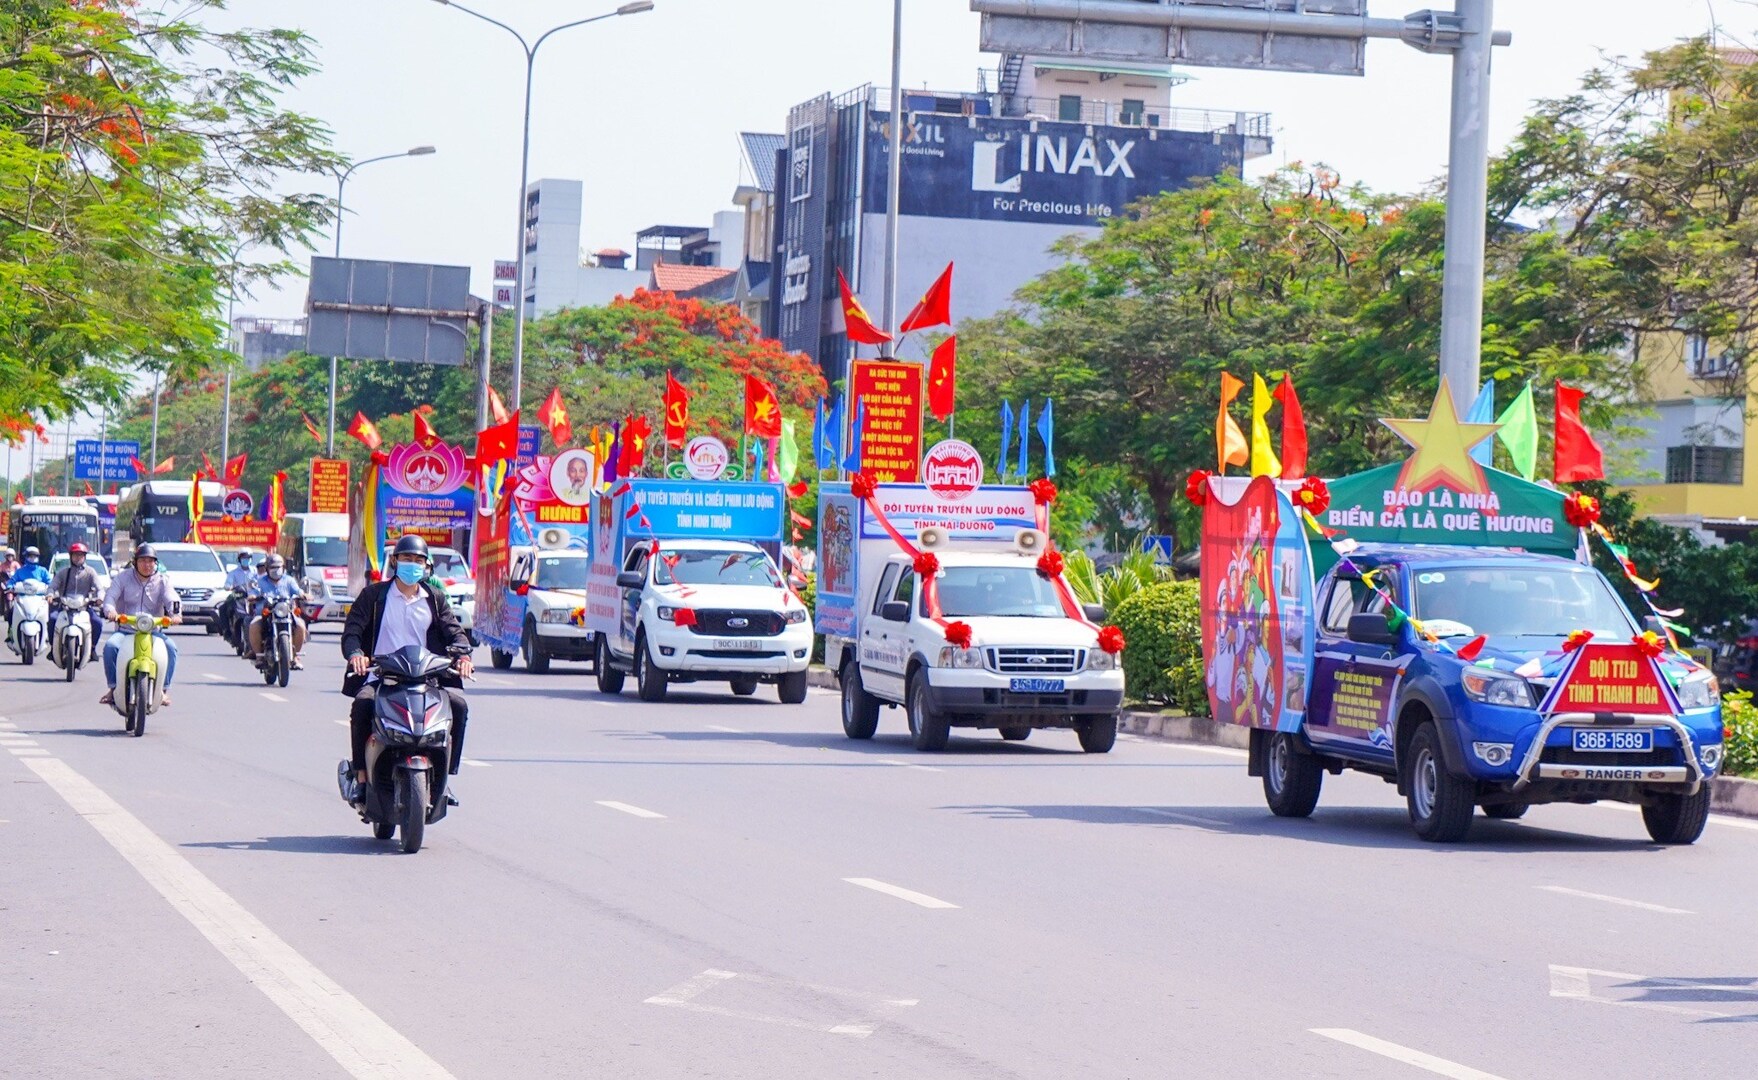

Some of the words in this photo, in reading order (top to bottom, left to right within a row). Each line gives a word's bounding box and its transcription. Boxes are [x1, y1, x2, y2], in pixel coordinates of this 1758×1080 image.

[1020, 134, 1135, 178] INAX
[993, 197, 1014, 211] For
[1018, 200, 1081, 214] Precious
[1086, 203, 1112, 217] Life
[497, 289, 510, 302] GA
[97, 446, 113, 454] SNG
[1382, 488, 1423, 506] ĐẢO
[1429, 489, 1454, 508] LÀ
[1459, 491, 1500, 510] NHÀ
[157, 506, 178, 515] VIP
[540, 505, 581, 521] HƯNG
[884, 503, 901, 514] ĐỘI
[997, 505, 1025, 518] ĐỘNG
[1328, 505, 1374, 526] BIỂN
[1380, 507, 1408, 528] CẢ
[1412, 510, 1438, 529] LÀ
[1443, 513, 1481, 531] QUÊ
[1486, 515, 1554, 534] HƯƠNG
[1589, 657, 1609, 681] ĐỘI
[1612, 660, 1638, 679] TTLĐ
[1568, 680, 1594, 703] TỈNH
[1597, 685, 1633, 704] THANH
[1636, 683, 1659, 705] HÓA
[1579, 732, 1643, 749] 36B-1589
[1585, 769, 1642, 780] RANGER
